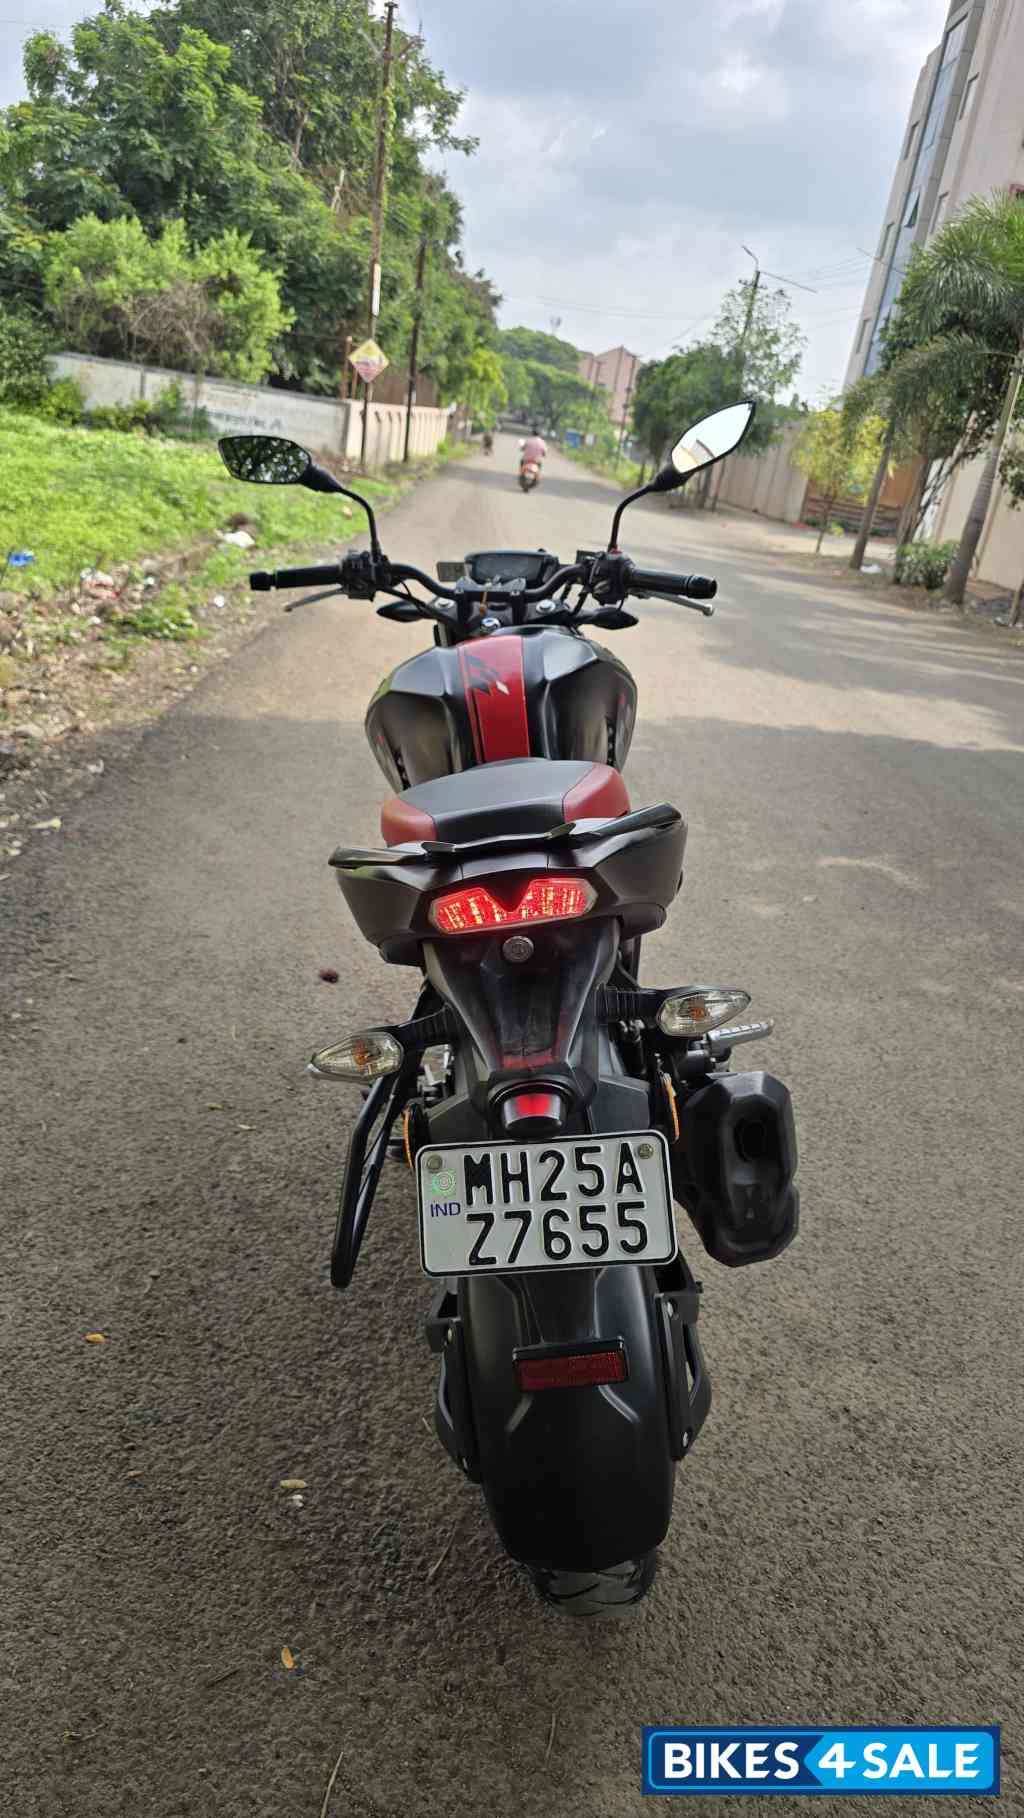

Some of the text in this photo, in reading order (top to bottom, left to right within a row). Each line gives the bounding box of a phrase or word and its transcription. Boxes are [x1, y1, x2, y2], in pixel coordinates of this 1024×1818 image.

[463, 1142, 643, 1206] MH25A
[430, 1202, 461, 1217] IND
[466, 1201, 648, 1266] Z7655
